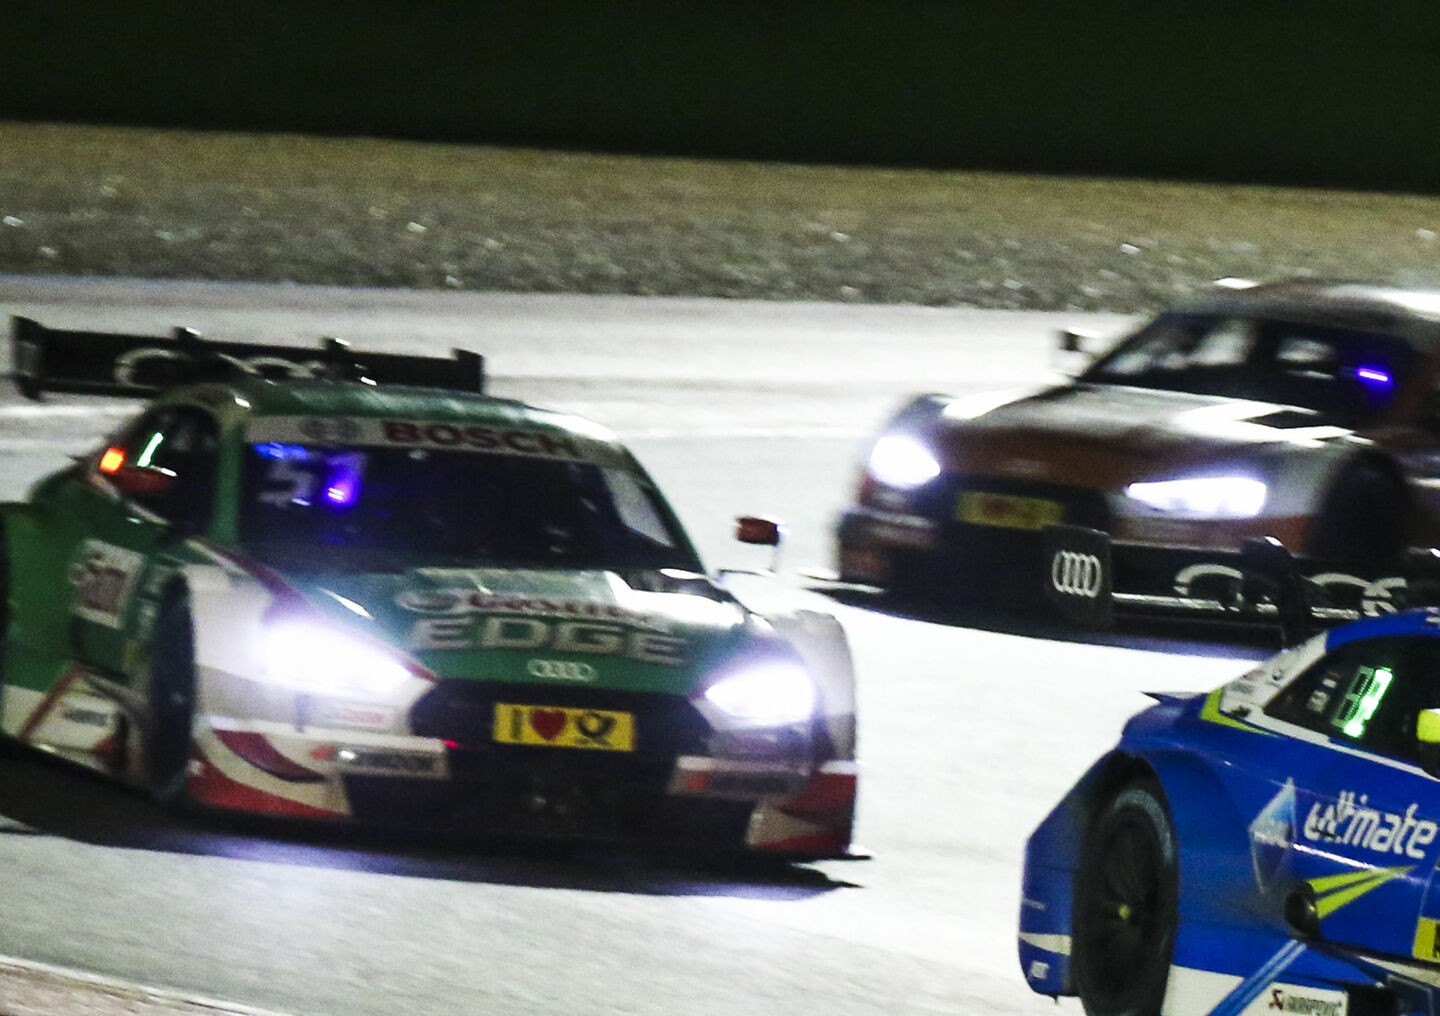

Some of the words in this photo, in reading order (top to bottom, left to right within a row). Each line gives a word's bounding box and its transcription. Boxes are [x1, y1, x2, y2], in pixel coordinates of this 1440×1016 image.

[381, 420, 578, 457] BOSCH
[408, 616, 687, 666] EDGE
[1304, 790, 1437, 859] ultimate
